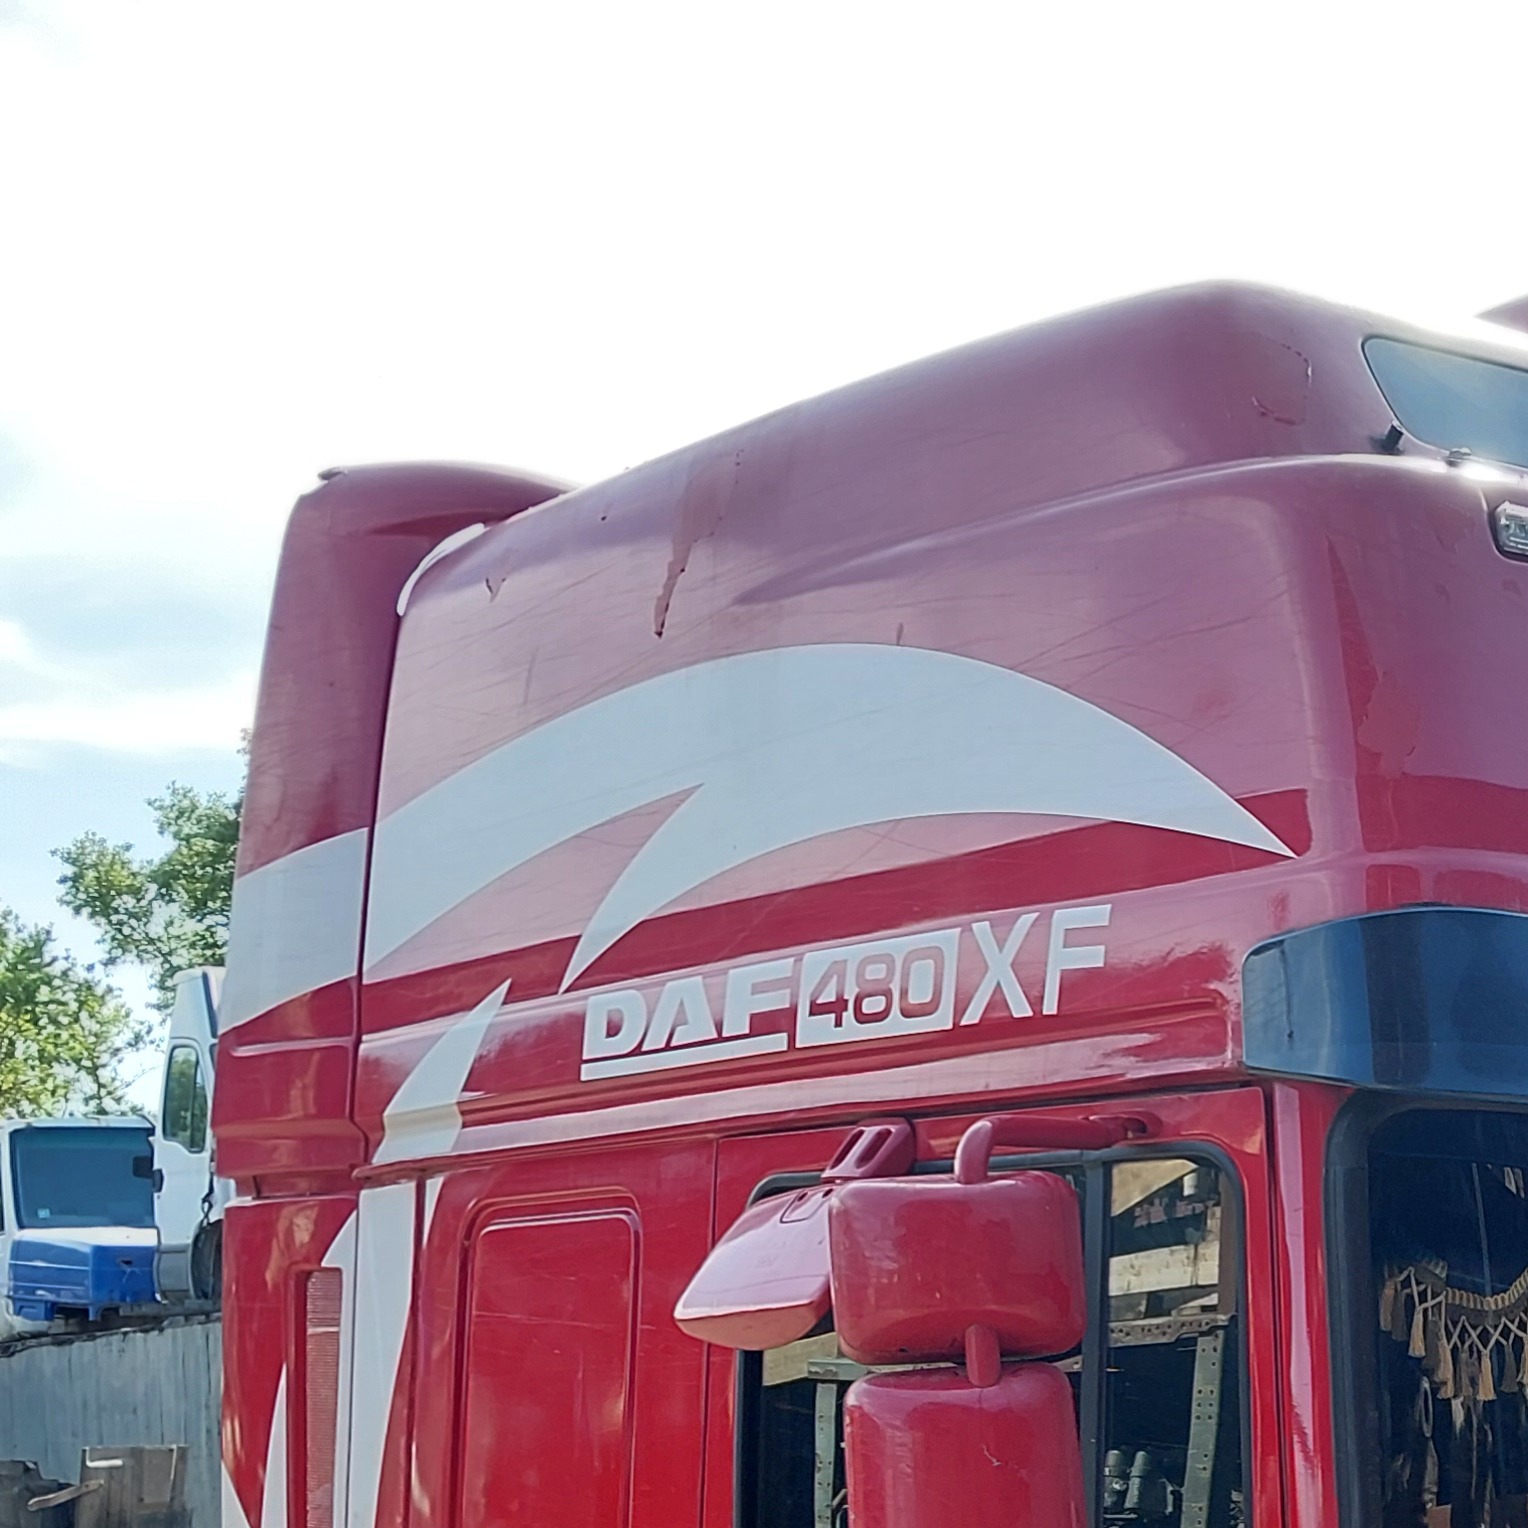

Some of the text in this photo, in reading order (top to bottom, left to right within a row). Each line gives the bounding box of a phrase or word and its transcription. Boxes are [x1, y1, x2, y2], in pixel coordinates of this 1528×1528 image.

[581, 904, 1112, 1060] DAF 480 XF
